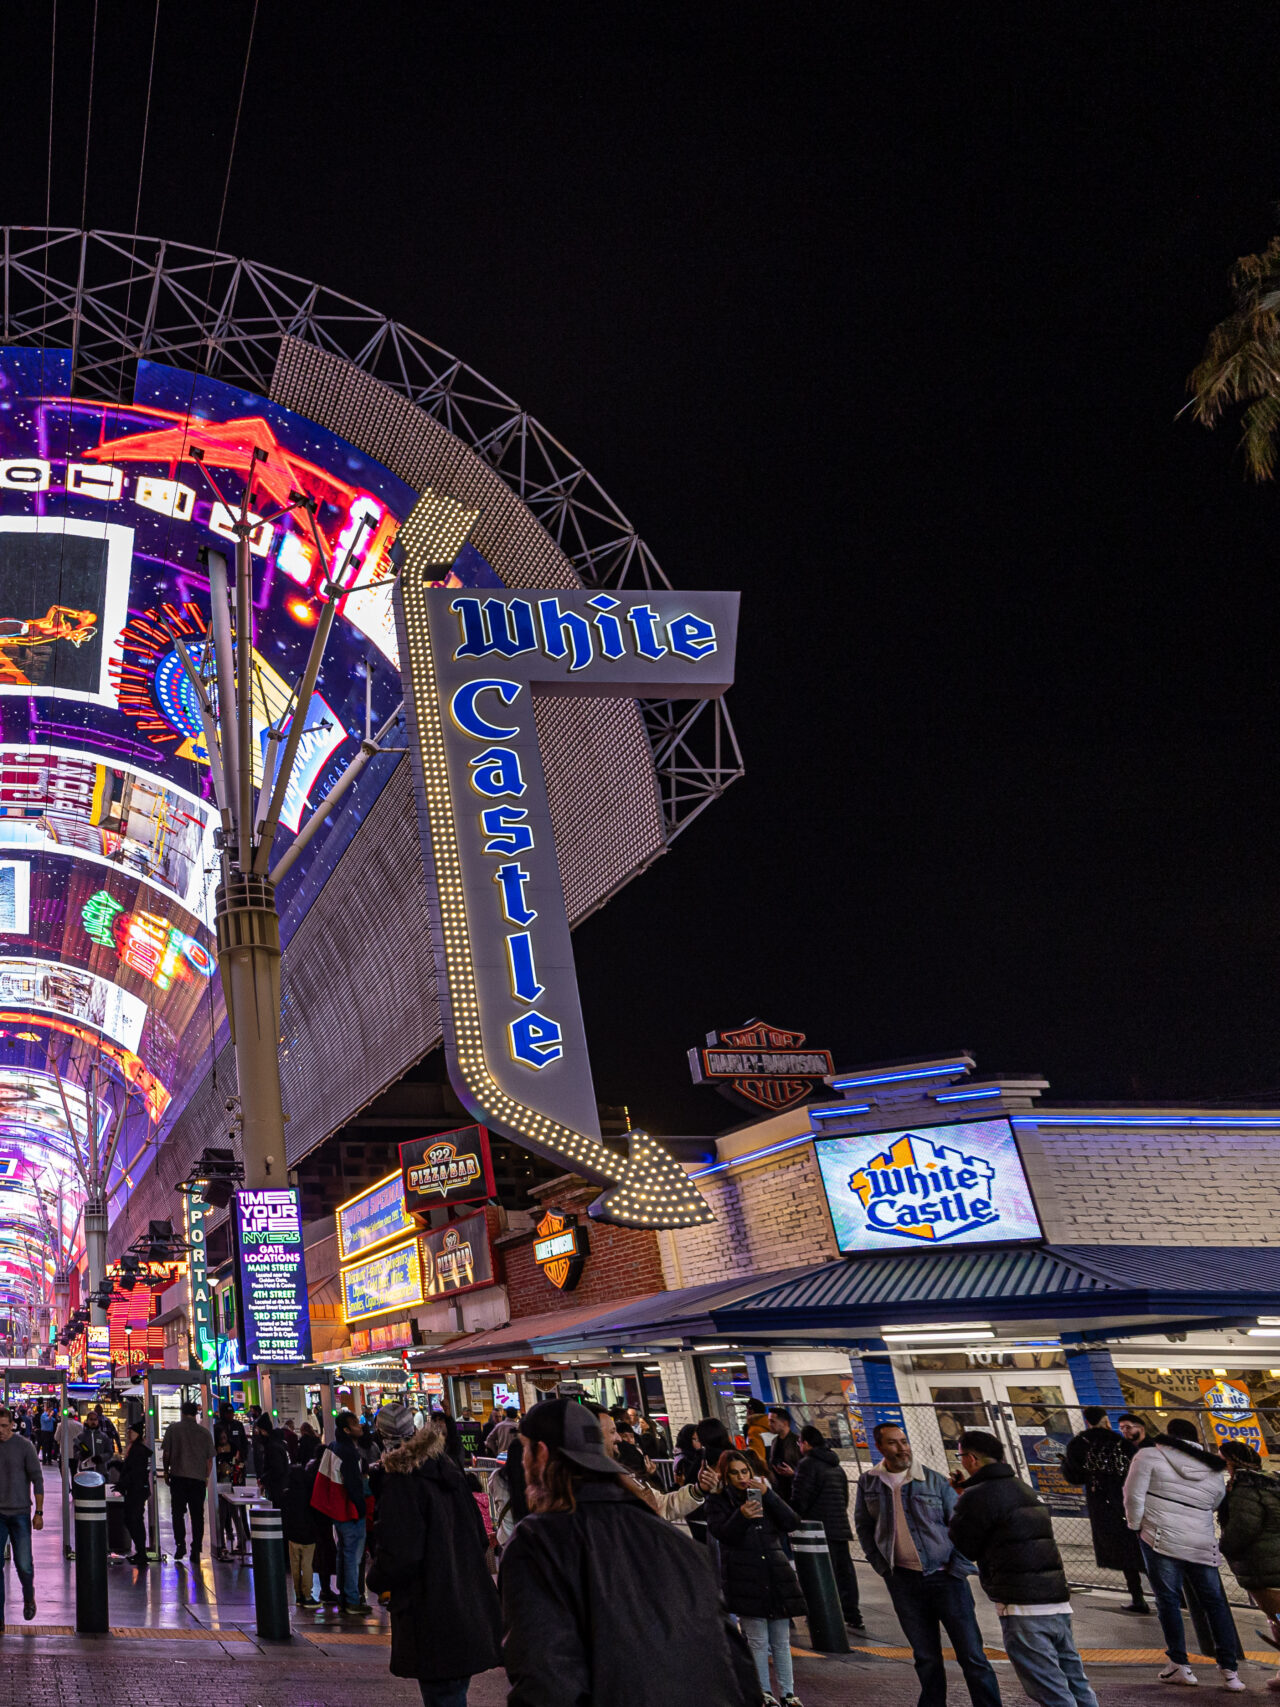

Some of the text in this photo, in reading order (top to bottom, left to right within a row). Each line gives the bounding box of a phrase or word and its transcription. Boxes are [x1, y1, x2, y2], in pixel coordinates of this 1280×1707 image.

[452, 597, 718, 671] White
[451, 678, 563, 1069] Castle
[81, 889, 125, 948] LUCKY
[733, 1030, 794, 1047] MOTOR
[709, 1053, 829, 1075] HARLEY-DAVIDSON
[429, 1148, 451, 1165] 322
[410, 1164, 448, 1186] PIZZA
[448, 1158, 476, 1178] BAR
[871, 1162, 978, 1201] White
[238, 1191, 290, 1205] TIME
[240, 1205, 298, 1218] YOUR
[867, 1195, 992, 1229] Castle
[242, 1218, 299, 1231] LIFE
[259, 1244, 284, 1253] GATE
[244, 1253, 300, 1262] LOCATIONS
[191, 1210, 207, 1321] PORTAL
[253, 1290, 296, 1298] 4TH STREET
[254, 1312, 298, 1320] 3RD STREET
[258, 1340, 298, 1348] 1ST STREET
[1148, 1375, 1174, 1385] LAS
[1215, 1423, 1260, 1438] Open
[461, 1435, 475, 1443] XIT
